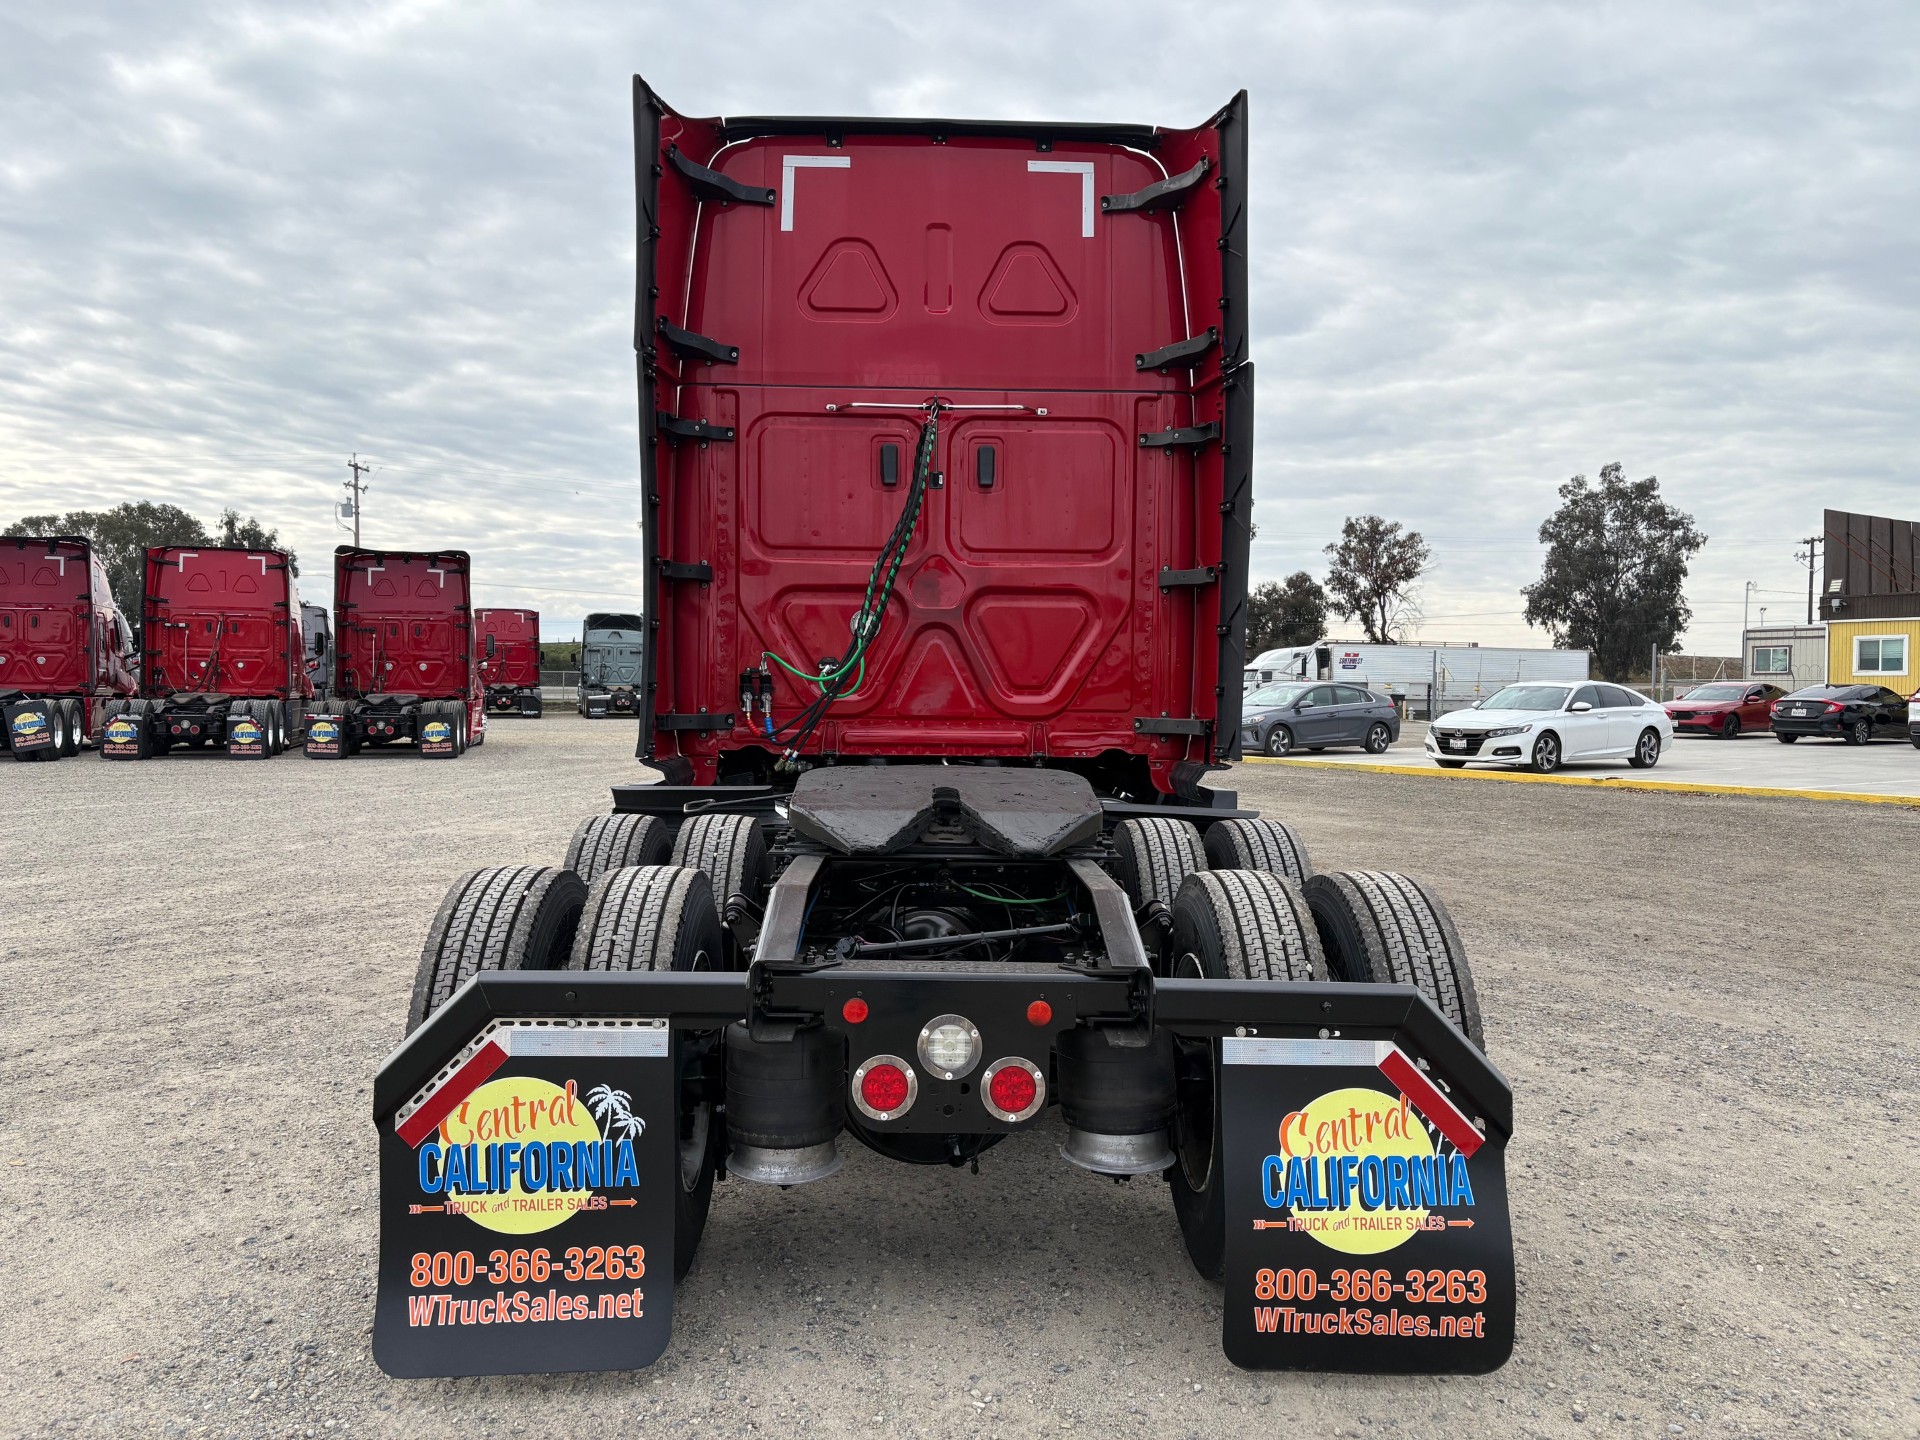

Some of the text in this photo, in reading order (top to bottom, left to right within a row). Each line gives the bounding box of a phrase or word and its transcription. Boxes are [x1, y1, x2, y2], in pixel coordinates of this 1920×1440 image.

[438, 1078, 578, 1149] Central
[1278, 1092, 1412, 1160] Central
[418, 1138, 640, 1195] CALIFORNIA
[1261, 1153, 1476, 1212] CALIFORNIA
[444, 1195, 608, 1215] TRUCK and TRAILER SALES
[1286, 1215, 1446, 1232] TRUCK and TRAILER SALES
[409, 1244, 646, 1287] 800-366-3263
[1254, 1267, 1487, 1304] 800-366-3263
[407, 1286, 645, 1327] WTruckSales.net
[1254, 1306, 1486, 1338] WTruckSales.net
